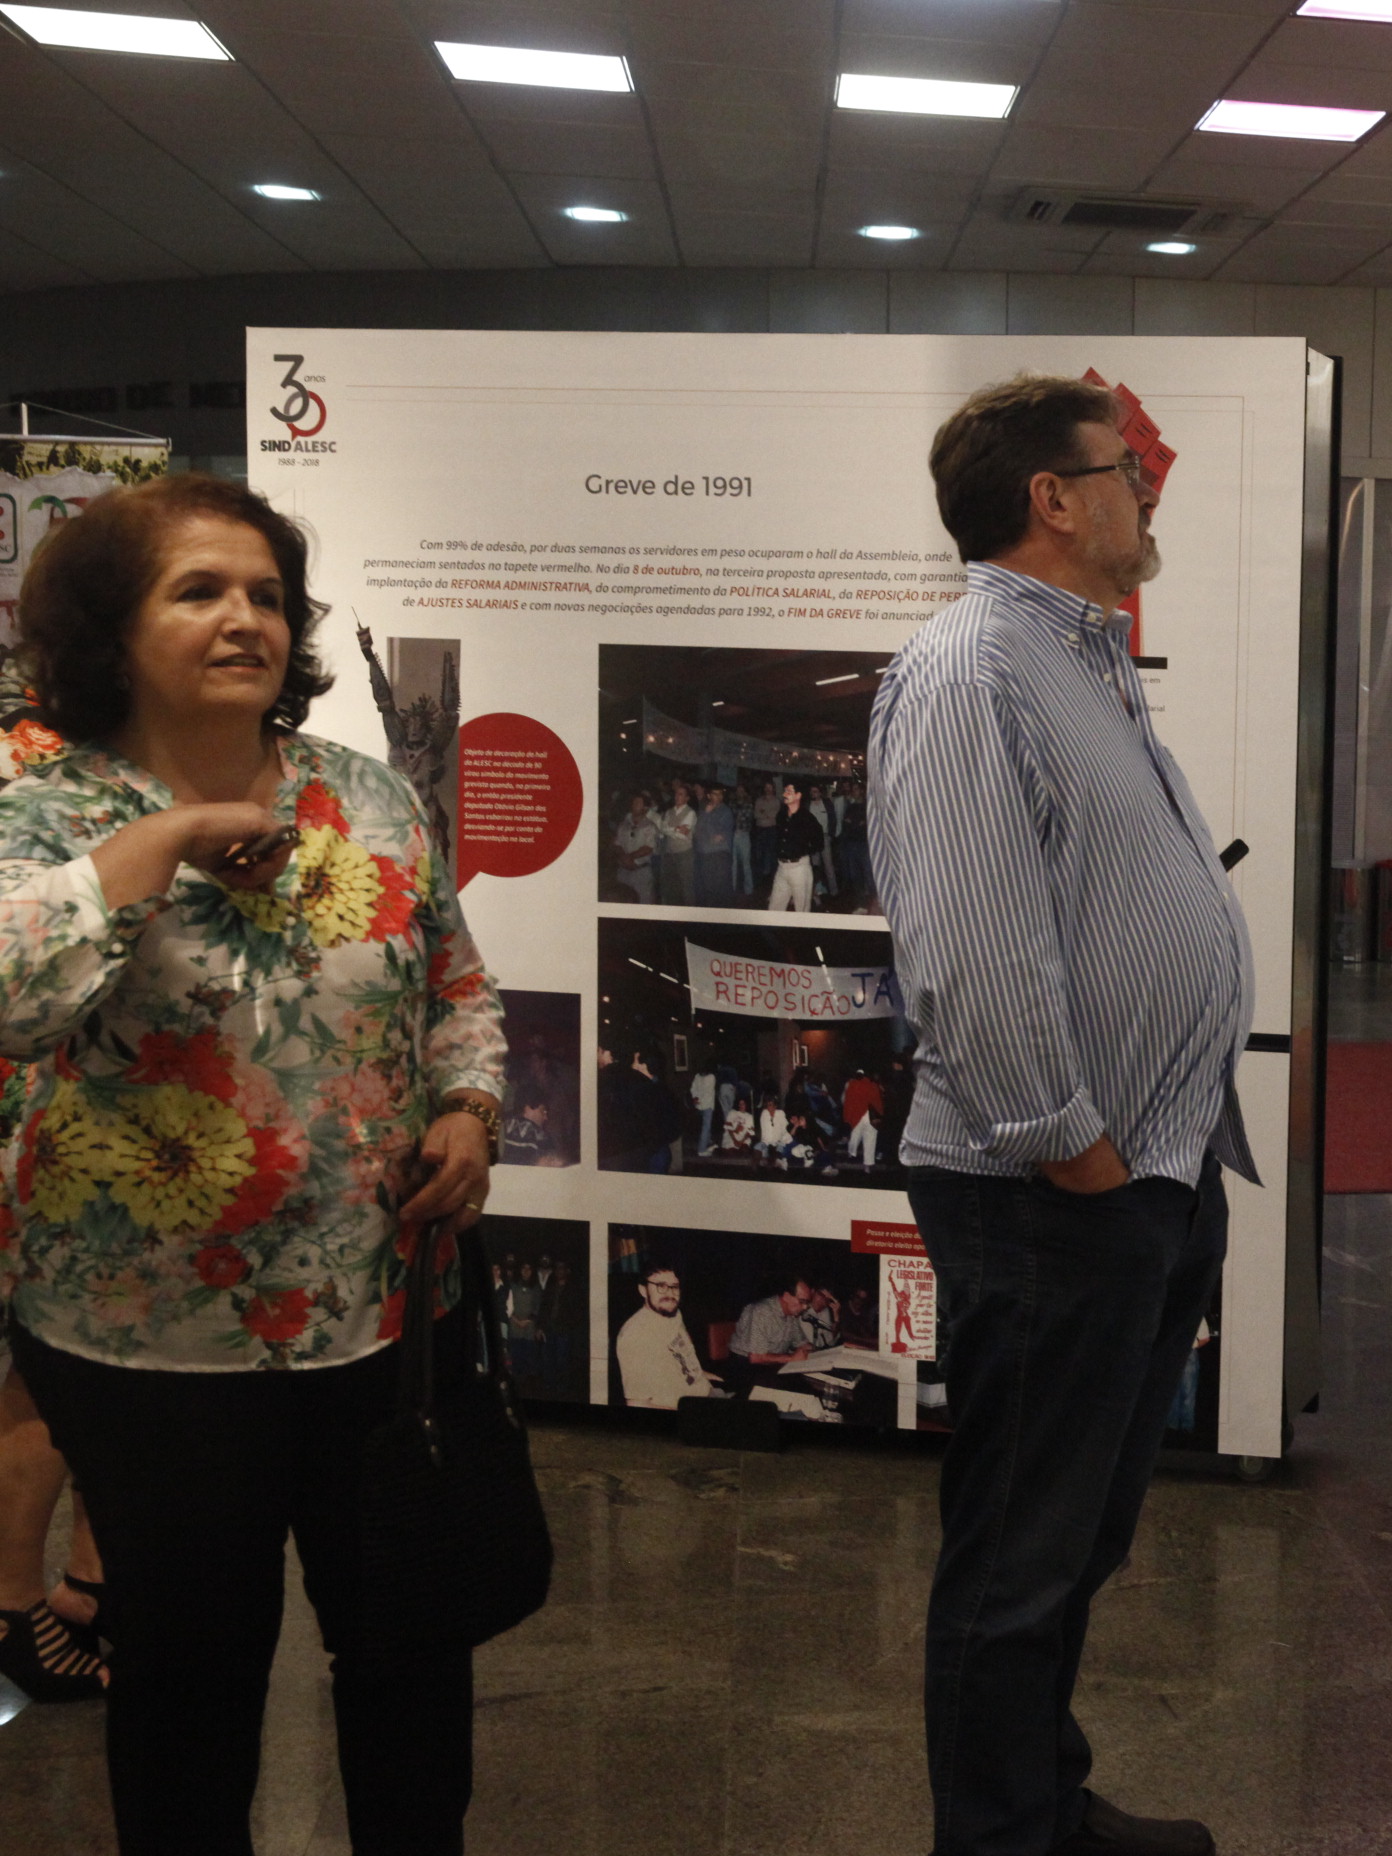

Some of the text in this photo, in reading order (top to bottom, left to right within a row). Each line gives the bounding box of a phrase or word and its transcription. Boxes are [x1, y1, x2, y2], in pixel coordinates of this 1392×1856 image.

[304, 375, 326, 383] anos
[585, 474, 752, 497] Greve de 1991
[420, 539, 952, 562] Com 99% de adesão, por duas semanas os servidores em peso ocuparam o hall da Assembleia, onde
[363, 559, 968, 584] permaneciam sentados no tapete vermelho. No dia 8 de outubro, na terceira proposta apresentada, com garantia
[366, 576, 967, 602] implantação da REFORMA ADMINISTRATIVA, do comprometimento da POLÍTICA SALARIAL, da REPOSIÇÃO DE PER
[710, 959, 812, 989] QUEREMOS
[715, 981, 850, 1016] REPOSIÇÃO
[888, 1259, 933, 1269] CHAPA
